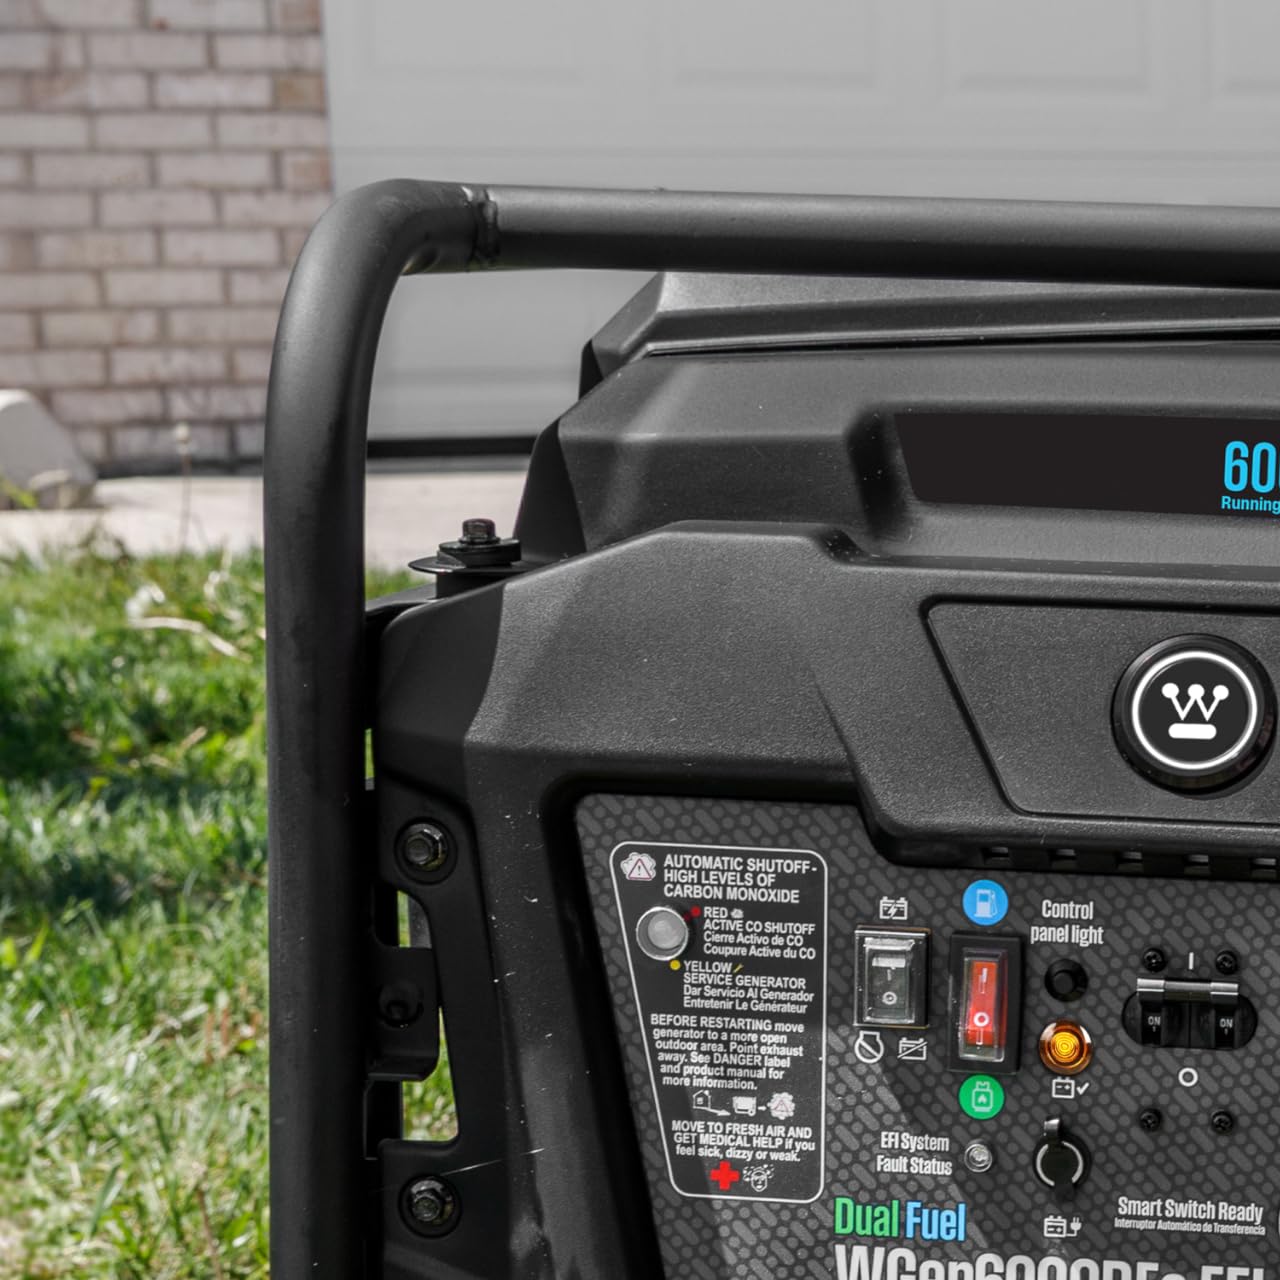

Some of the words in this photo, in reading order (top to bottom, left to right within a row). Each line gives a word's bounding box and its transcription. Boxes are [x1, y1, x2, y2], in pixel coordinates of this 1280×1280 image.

[1221, 495, 1280, 514] Running
[664, 854, 743, 870] AUTOMATIC
[664, 869, 697, 883] HIGH
[701, 871, 753, 886] LEVELS
[757, 873, 775, 887] OF
[664, 883, 722, 899] CARBON
[726, 887, 799, 903] MONOXIDE
[704, 907, 728, 918] RED
[1042, 900, 1094, 920] Control
[703, 919, 743, 931] ACTIVE
[745, 921, 762, 932] CO
[764, 922, 815, 935] SHUTOFF
[1031, 925, 1069, 944] panel
[1072, 924, 1104, 947] light
[704, 931, 734, 943] Cierre
[736, 932, 769, 945] Activo
[771, 934, 784, 945] de
[786, 935, 803, 946] CO
[703, 943, 747, 958] Coupure
[748, 945, 781, 957] Active
[783, 947, 797, 958] du
[799, 947, 815, 959] CO
[684, 960, 734, 973] YELLOW
[683, 972, 732, 985] SERVICE
[735, 975, 805, 989] GENERATOR
[683, 984, 701, 996] Dar
[703, 985, 745, 998] Servicio
[760, 988, 814, 1001] Generador
[683, 996, 733, 1009] Entretenir
[735, 999, 748, 1010] Le
[651, 1014, 697, 1027] BEFORE
[700, 1016, 772, 1031] RESTARTING
[774, 1023, 804, 1032] move
[1148, 1016, 1160, 1026] ON
[1220, 1018, 1232, 1028] ON
[652, 1026, 705, 1042] generator
[707, 1029, 718, 1040] to
[730, 1033, 758, 1042] more
[760, 1034, 787, 1046] open
[655, 1037, 698, 1050] outdoor
[730, 1042, 758, 1054] Point
[760, 1043, 803, 1056] exhaust
[690, 1052, 710, 1063] See
[713, 1053, 762, 1066] DANGER
[764, 1055, 790, 1067] label
[660, 1062, 680, 1074] and
[683, 1063, 724, 1079] product
[727, 1065, 766, 1078] manual
[768, 1068, 785, 1079] for
[662, 1076, 690, 1086] more
[672, 1120, 704, 1132] MOVE
[707, 1122, 723, 1133] TO
[725, 1123, 763, 1136] FRESH
[765, 1125, 785, 1137] AIR
[787, 1126, 812, 1138] AND
[674, 1132, 697, 1144] GET
[699, 1133, 750, 1147] MEDICAL
[752, 1136, 783, 1149] HELP
[794, 1141, 815, 1153] you
[881, 1132, 900, 1149] EFI
[901, 1133, 949, 1153] System
[676, 1144, 695, 1156] feel
[725, 1147, 753, 1162] dizzy
[877, 1155, 908, 1172] Fault
[910, 1158, 952, 1176] Status
[1118, 1196, 1162, 1216] Smart
[1165, 1199, 1215, 1219] Switch
[1218, 1202, 1263, 1225] Ready
[834, 1198, 900, 1237] Dual
[906, 1202, 966, 1242] Fuel
[1114, 1218, 1156, 1230] Interruptor
[1157, 1220, 1201, 1232] Automático
[1203, 1223, 1212, 1232] de
[1214, 1223, 1265, 1236] Transferencia
